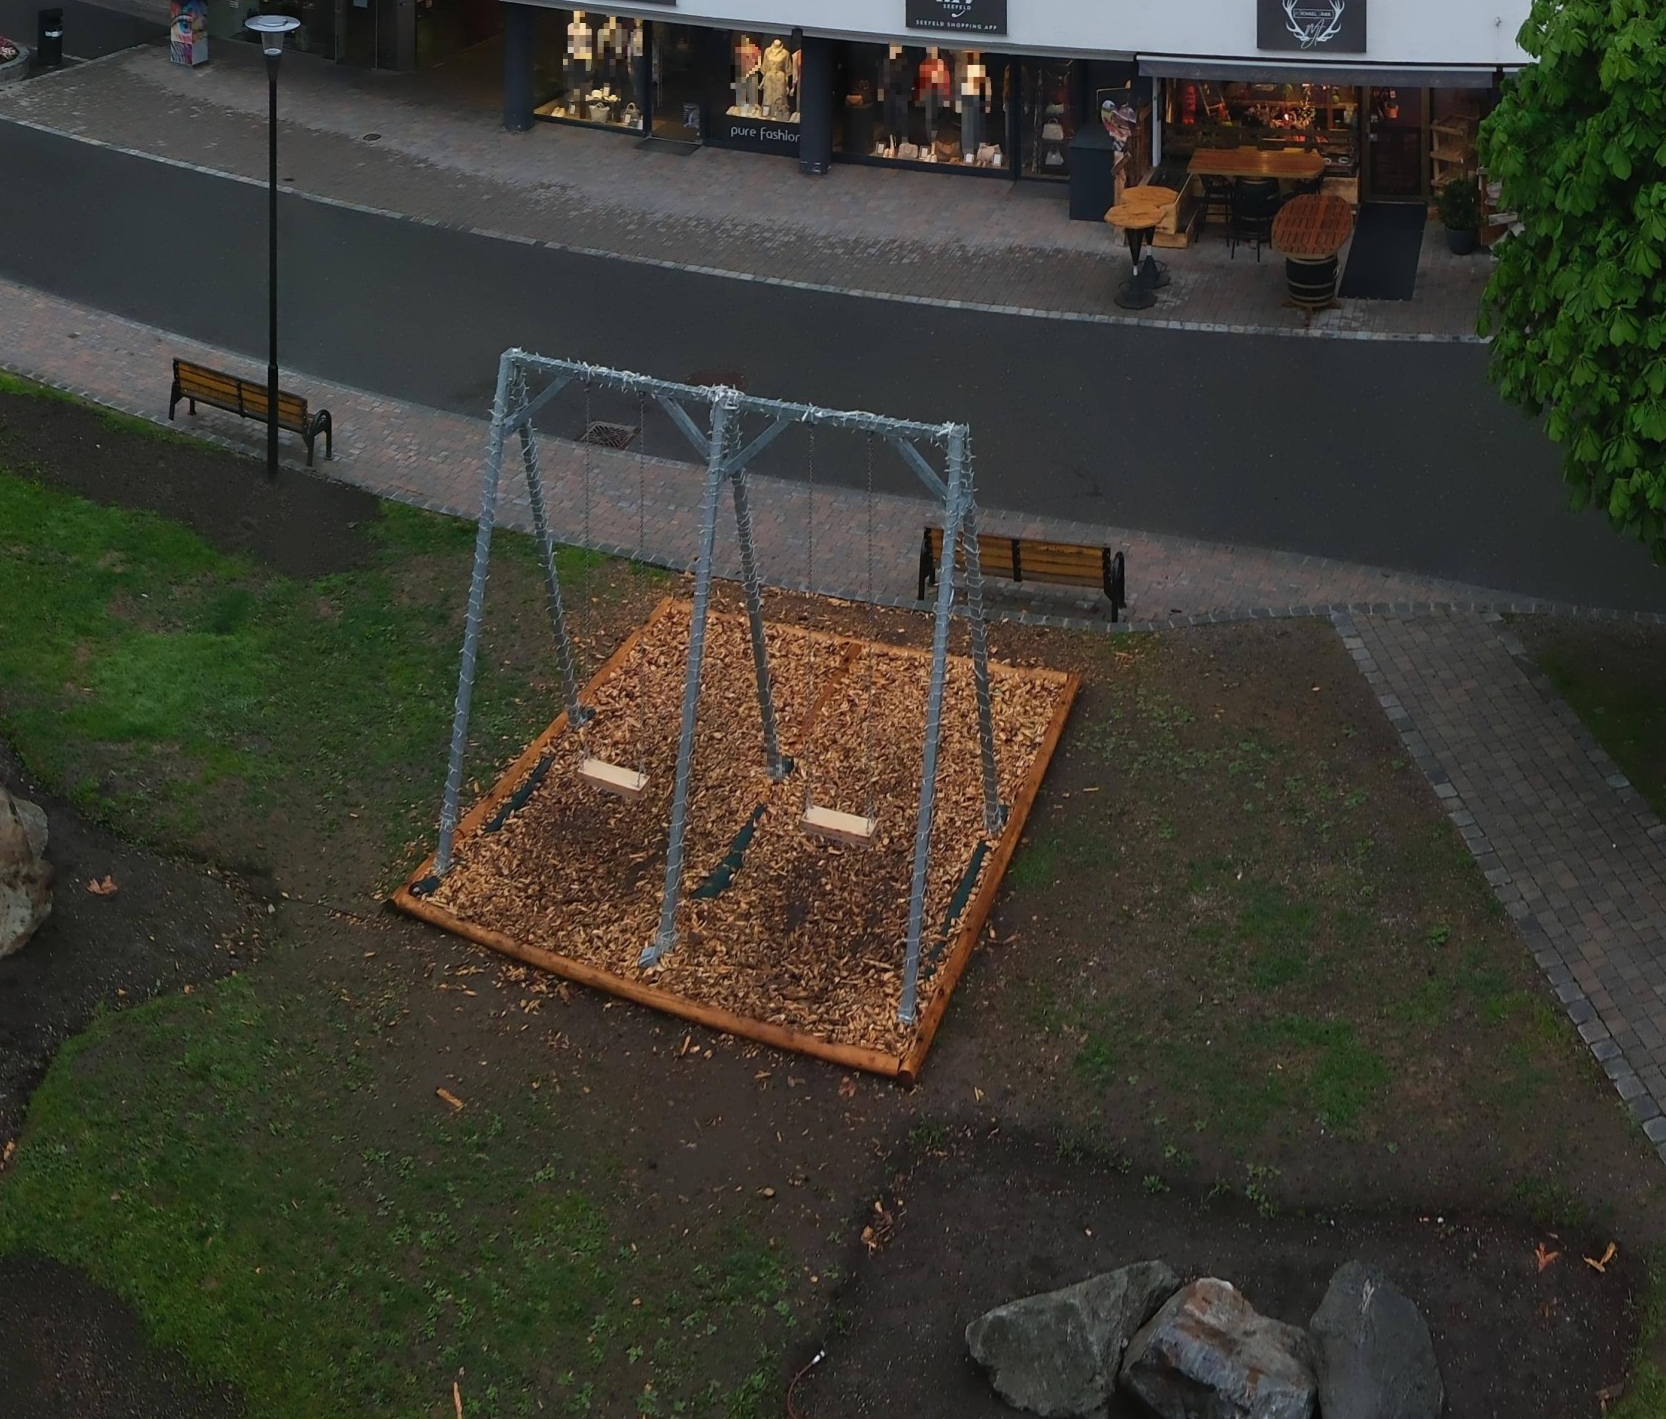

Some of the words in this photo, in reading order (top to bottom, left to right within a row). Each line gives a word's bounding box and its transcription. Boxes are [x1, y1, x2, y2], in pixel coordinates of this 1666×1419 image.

[943, 3, 972, 11] SEEFELD
[915, 19, 945, 27] SEEFELD
[946, 21, 982, 30] SHOPPING
[730, 126, 757, 138] pure
